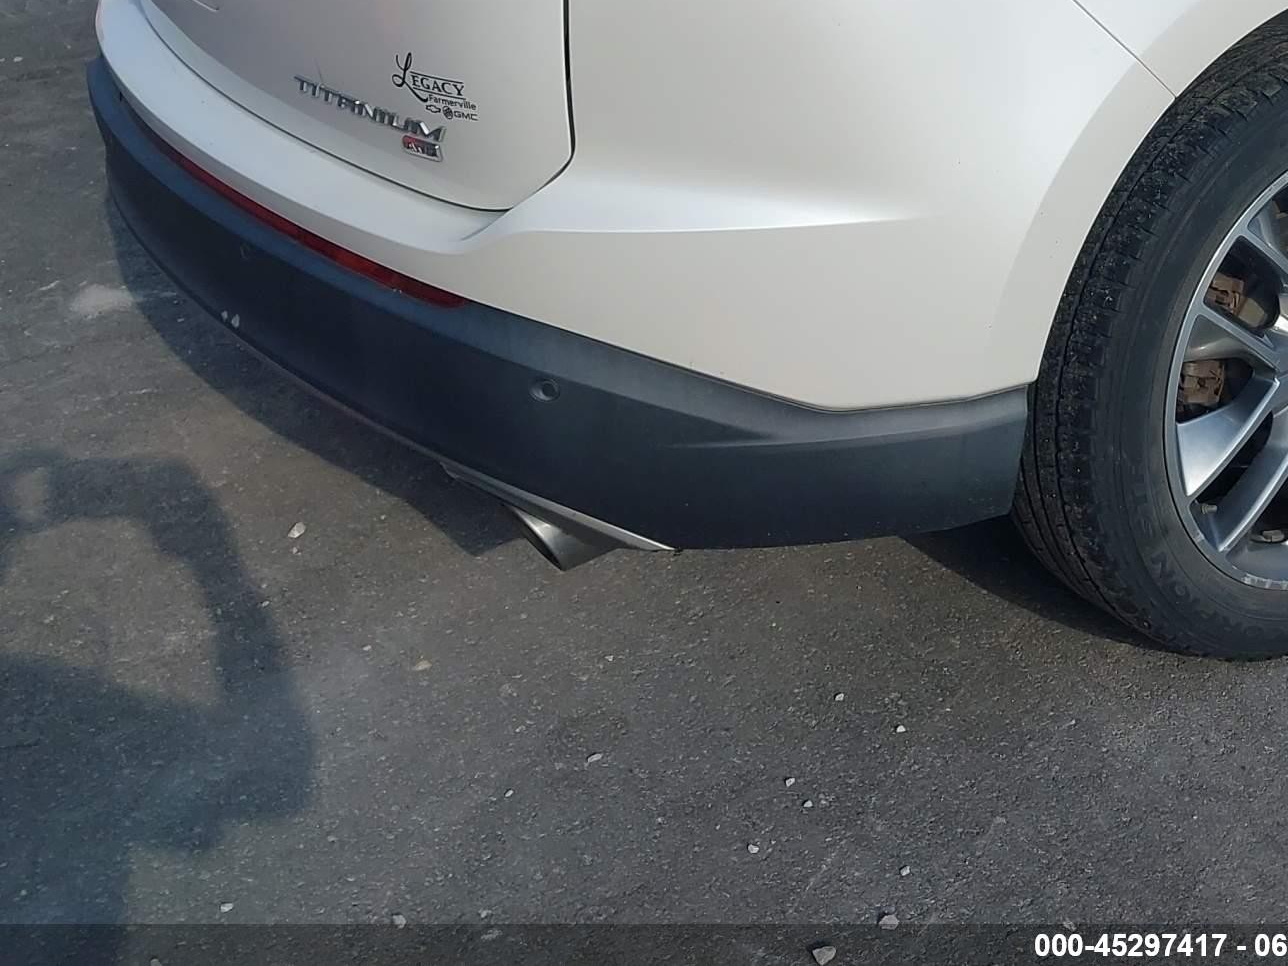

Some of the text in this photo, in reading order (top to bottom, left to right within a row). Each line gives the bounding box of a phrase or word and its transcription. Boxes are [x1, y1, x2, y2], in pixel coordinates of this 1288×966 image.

[391, 52, 465, 103] LEGACY
[293, 75, 447, 143] TITANIUM
[428, 94, 477, 111] Farmerville
[453, 110, 480, 122] GMC
